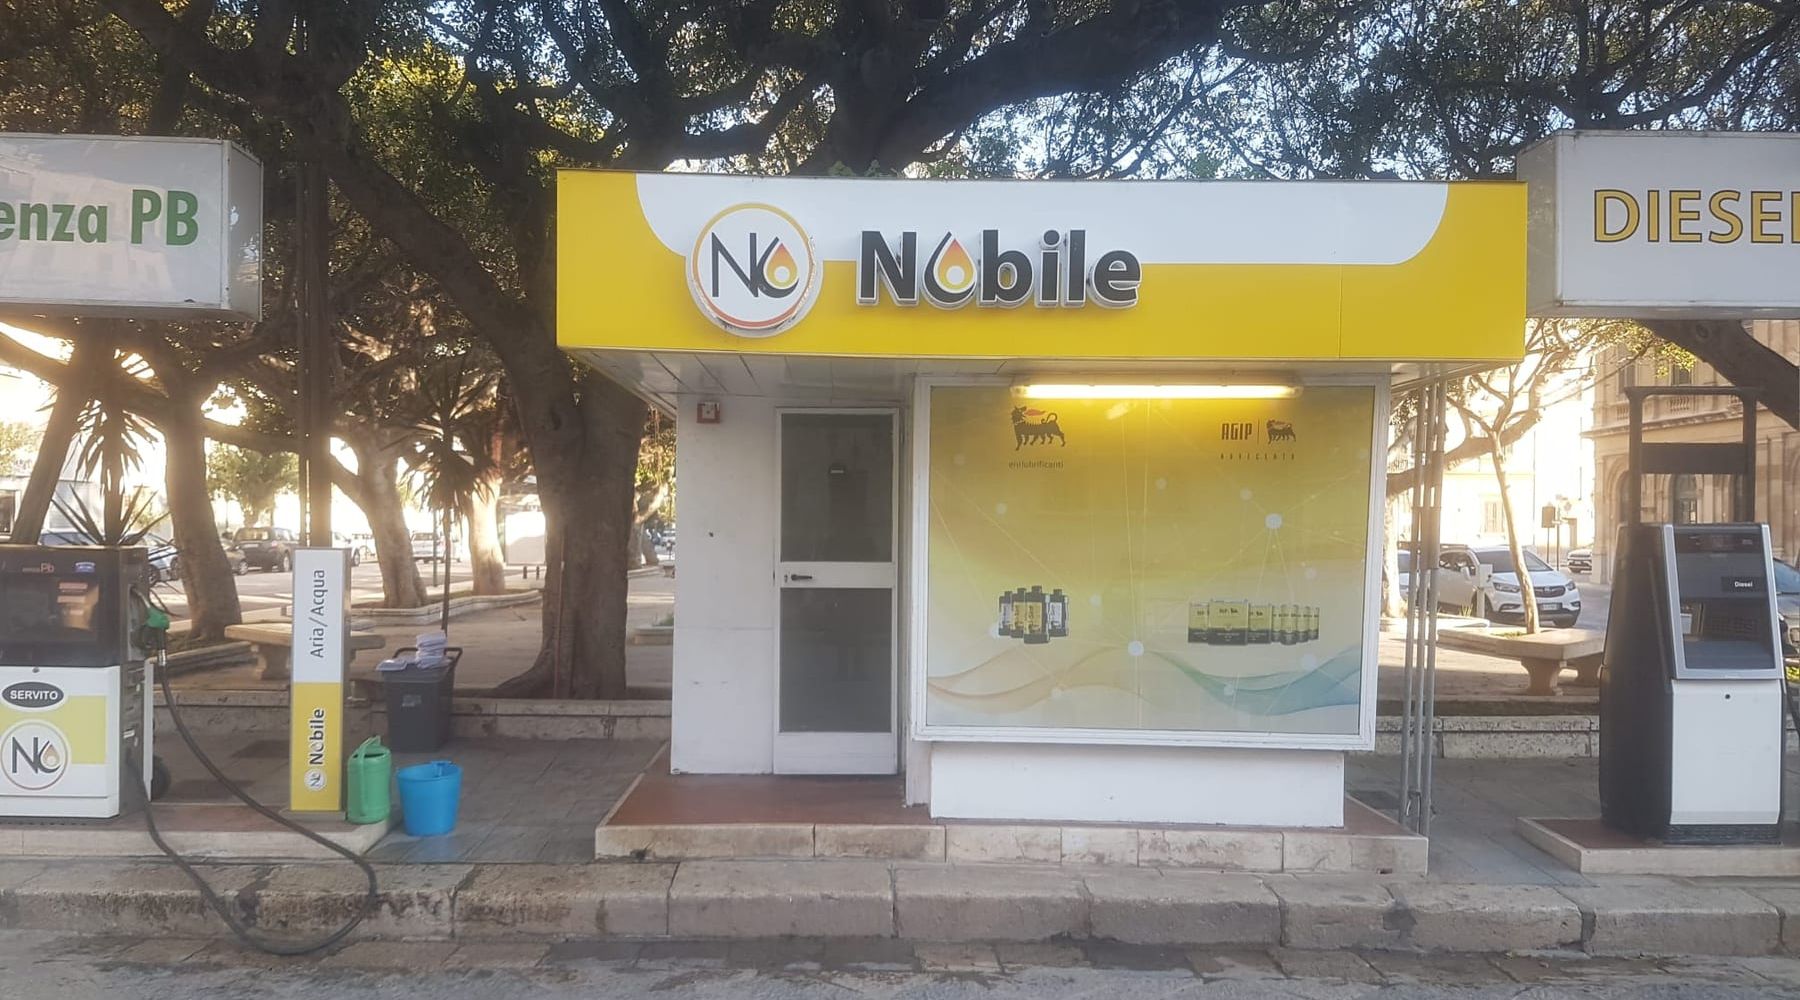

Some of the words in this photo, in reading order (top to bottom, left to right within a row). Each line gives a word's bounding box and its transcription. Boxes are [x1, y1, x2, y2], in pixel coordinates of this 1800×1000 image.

[131, 189, 199, 246] PB
[857, 229, 1142, 307] Nobile
[1221, 423, 1253, 441] AGIP
[309, 570, 327, 658] Aria/Acqua
[9, 689, 58, 701] SERVITO
[309, 709, 325, 765] Nobile
